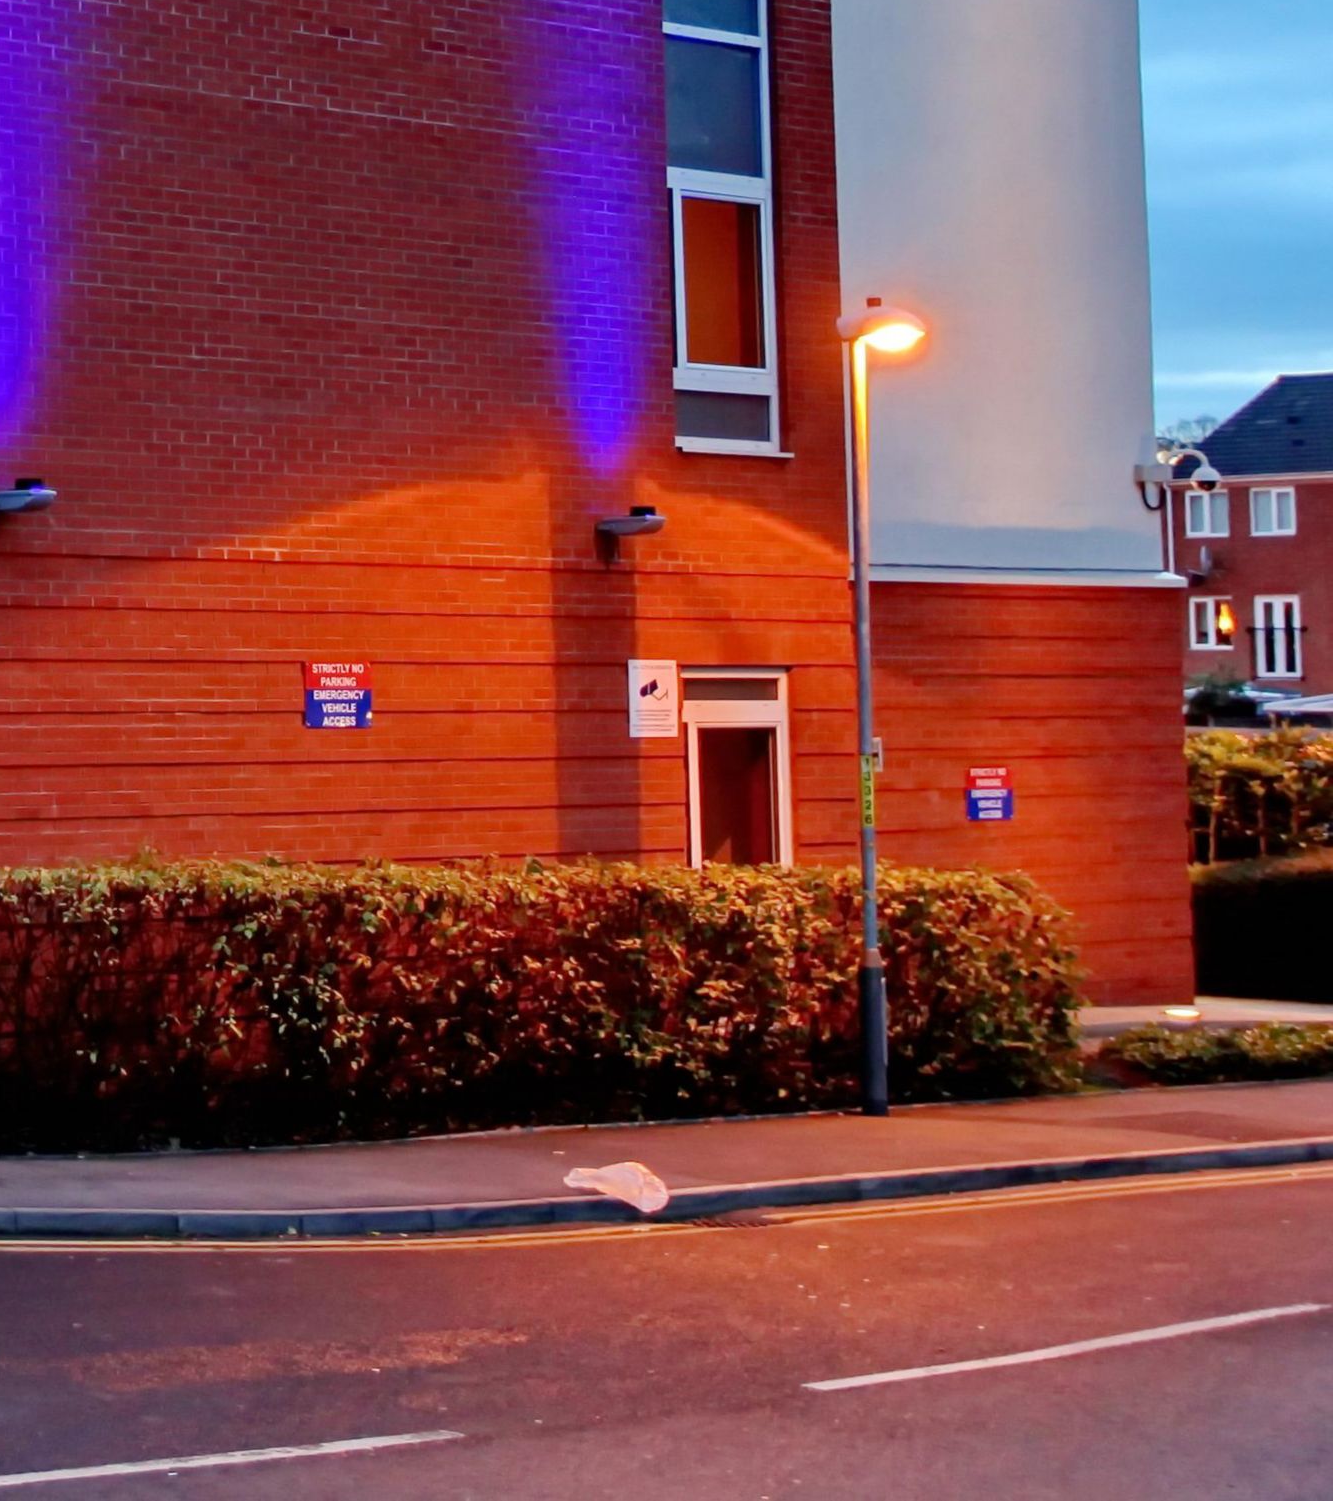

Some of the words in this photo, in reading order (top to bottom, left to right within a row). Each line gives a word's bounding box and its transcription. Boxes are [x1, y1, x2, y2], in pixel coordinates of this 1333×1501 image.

[312, 663, 350, 674] STRICTLY
[351, 663, 365, 674] NO
[320, 676, 357, 687] PARKING
[313, 690, 365, 700] EMERGENCY
[321, 702, 357, 713] VEHICLE
[322, 716, 356, 727] ACCESS
